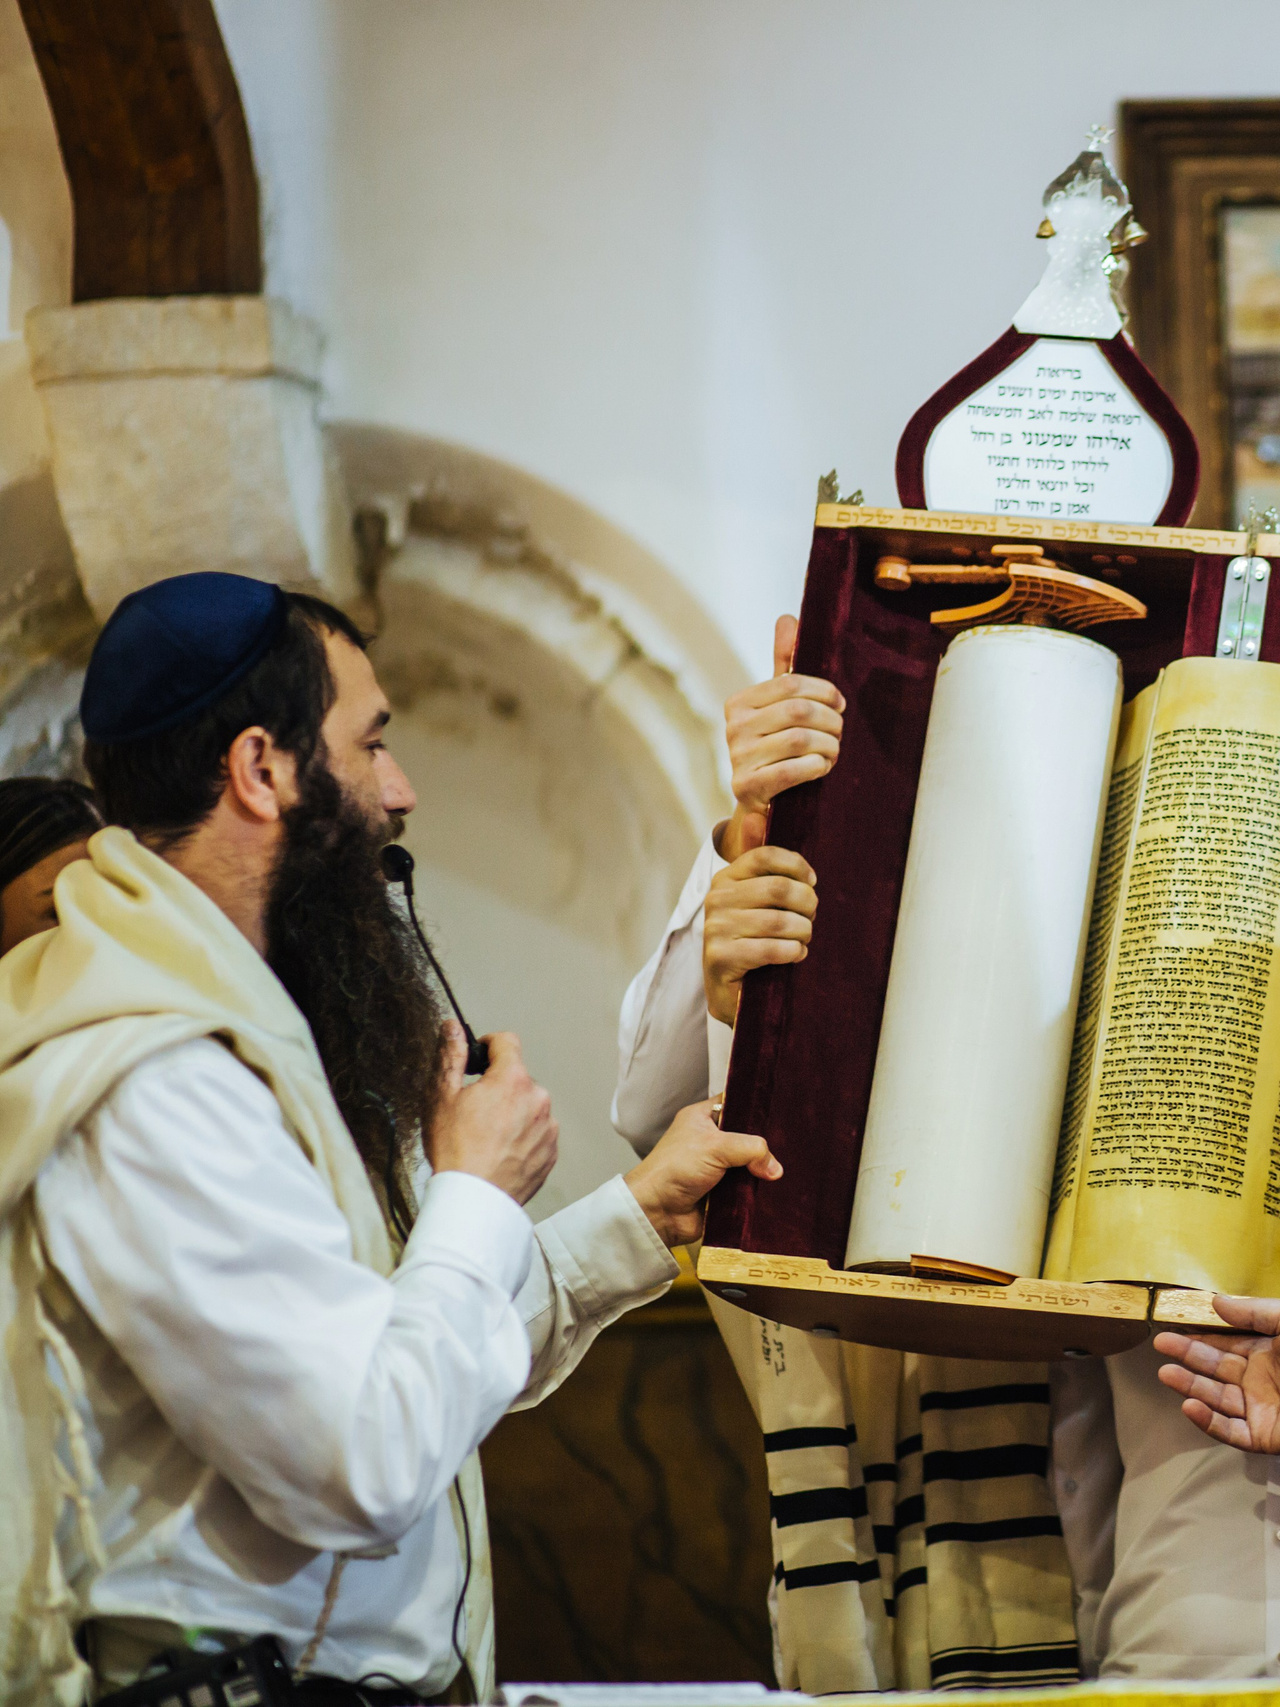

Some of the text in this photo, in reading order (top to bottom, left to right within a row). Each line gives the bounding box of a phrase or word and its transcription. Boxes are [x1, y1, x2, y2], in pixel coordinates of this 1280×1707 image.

[1036, 366, 1081, 380] בריאות
[998, 385, 1116, 403] אריכות ימים ושנים
[967, 404, 1022, 419] המשפחה
[1059, 406, 1096, 423] שלמה
[1103, 412, 1141, 425] רפואה
[971, 425, 1132, 451] אליהו שמעוני בן רחל
[987, 453, 1109, 473] לילדיו כלותיו חתניו
[997, 474, 1094, 494] וכל יוצאי חלציו
[994, 498, 1090, 516] אמן כן יהי רצון
[748, 1267, 1090, 1308] ושבתי בבית יהוה לאורך ימים
